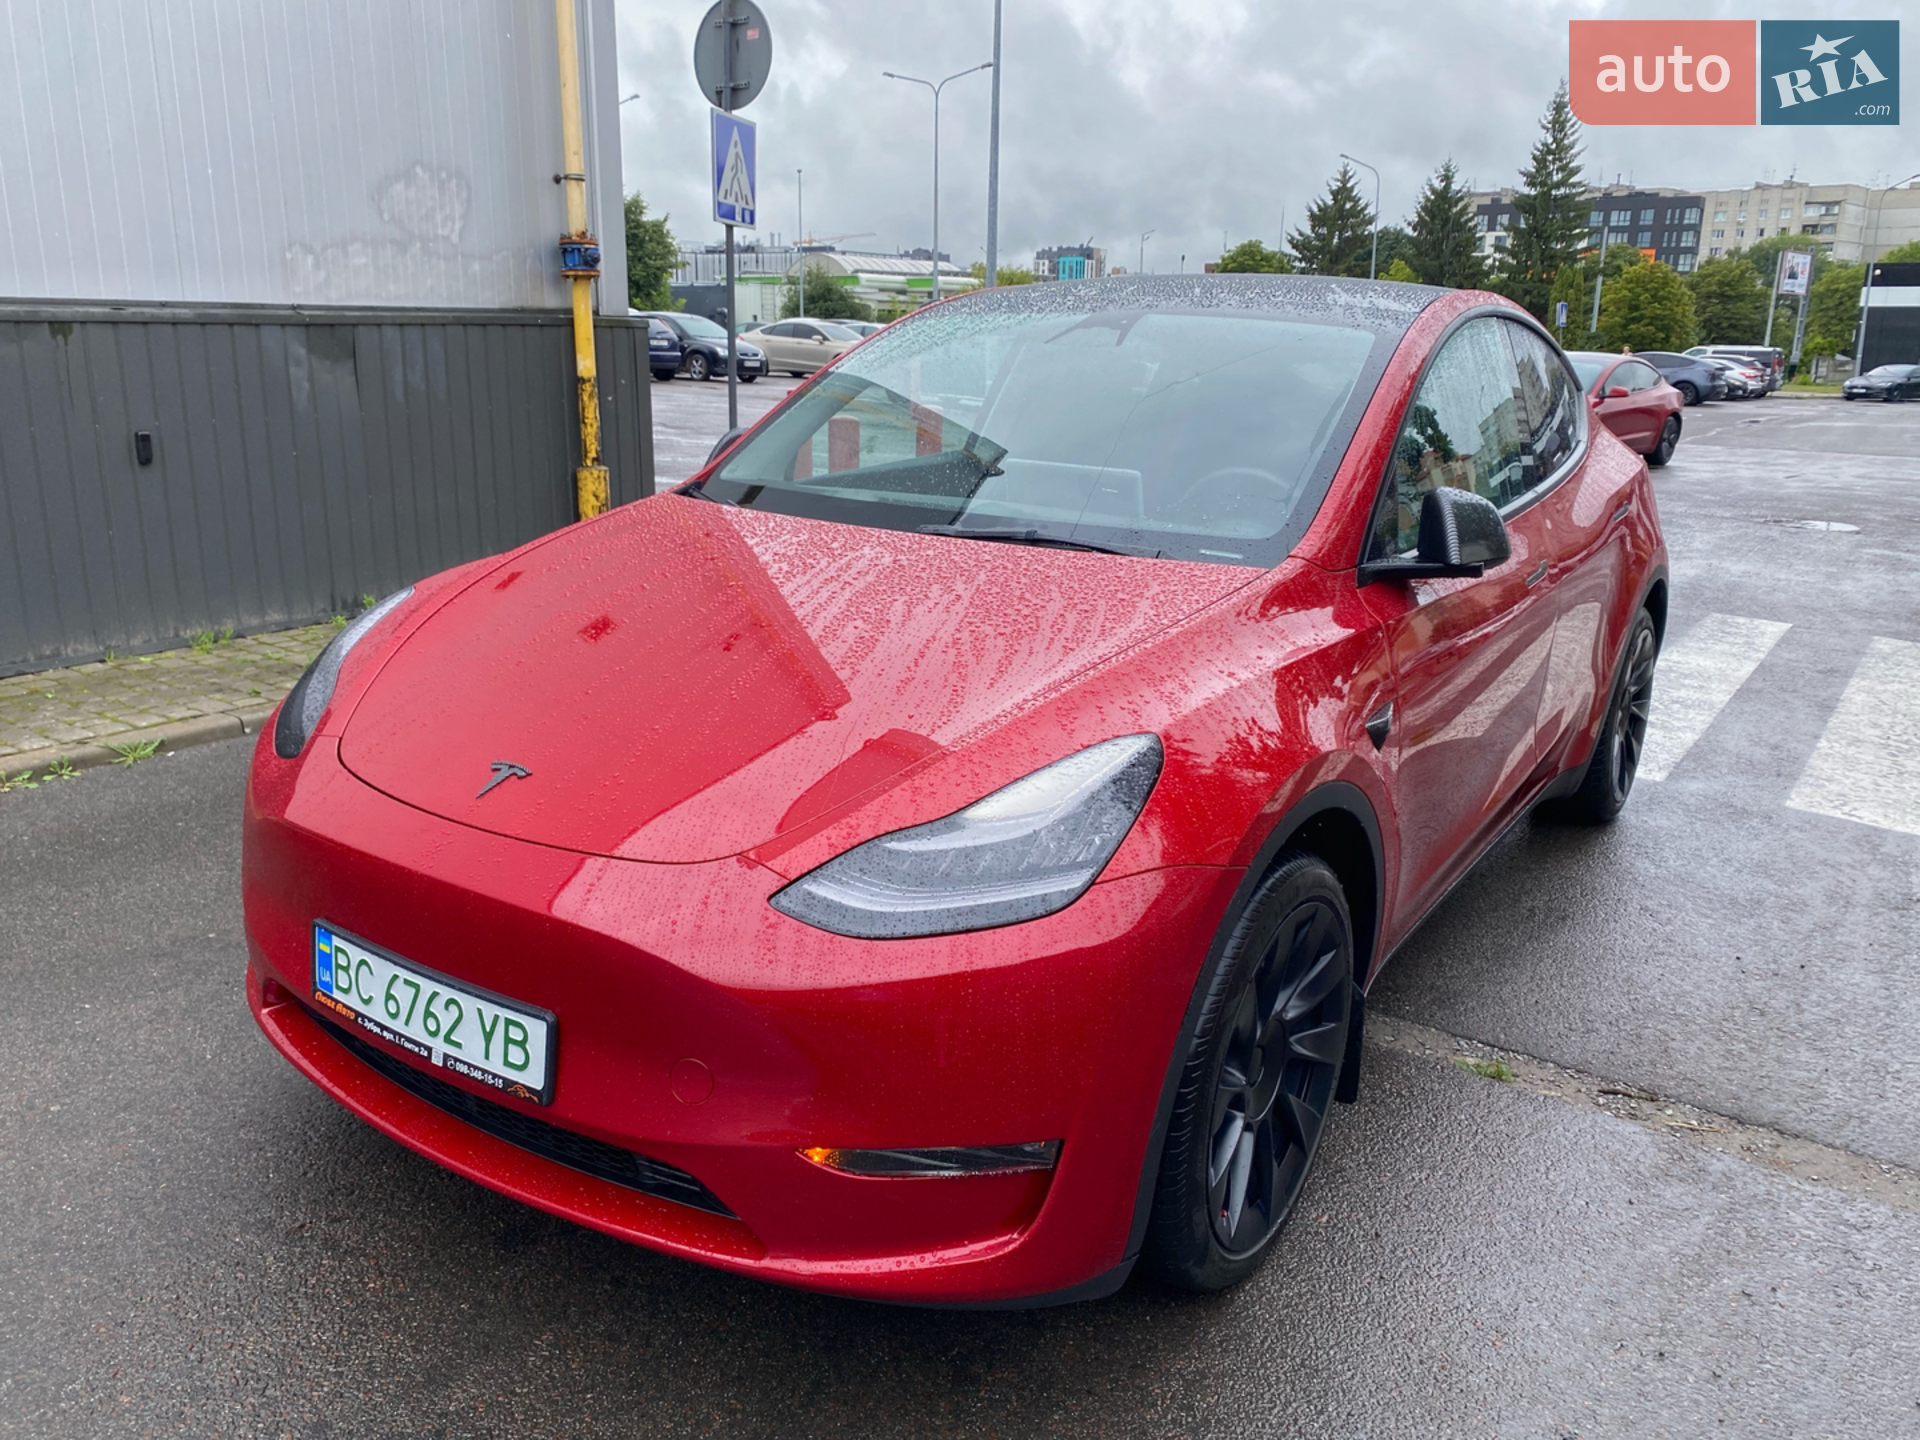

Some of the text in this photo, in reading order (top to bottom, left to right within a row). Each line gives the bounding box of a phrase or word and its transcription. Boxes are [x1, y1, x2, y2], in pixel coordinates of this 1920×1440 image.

[319, 966, 332, 985] UA
[334, 944, 531, 1072] BC 6762 YB
